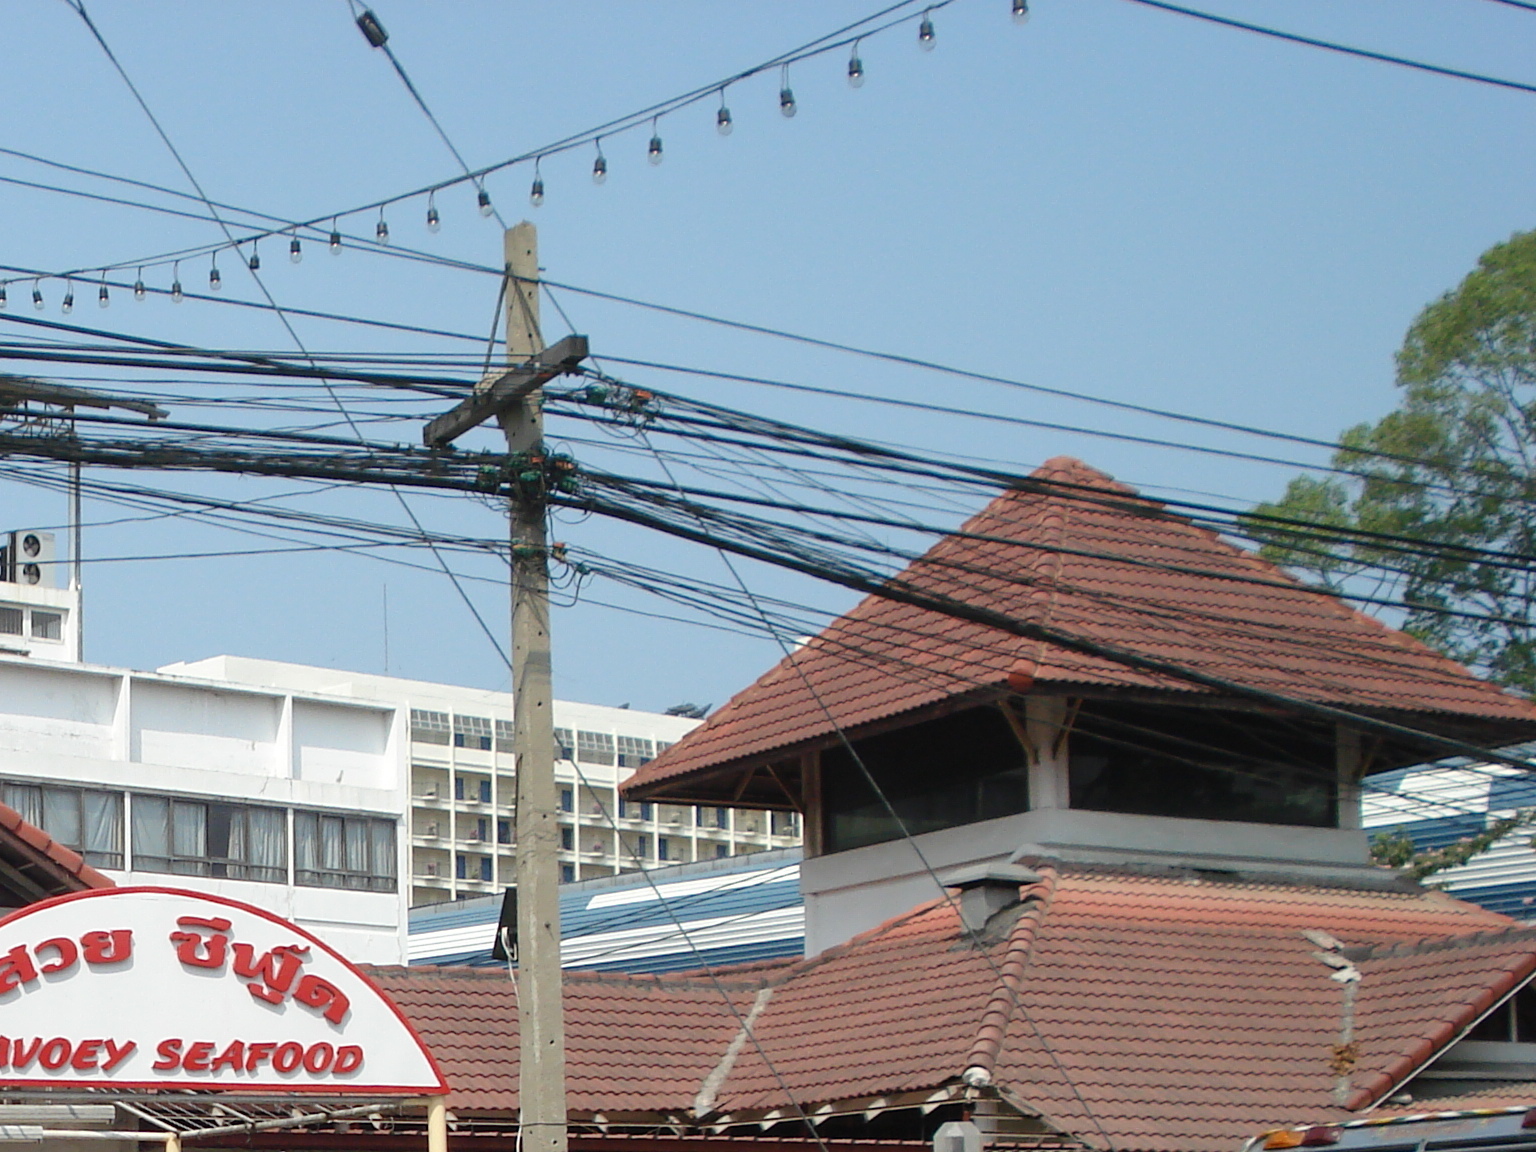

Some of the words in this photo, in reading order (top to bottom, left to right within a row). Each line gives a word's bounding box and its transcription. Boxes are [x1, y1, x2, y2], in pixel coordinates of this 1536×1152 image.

[170, 916, 352, 1024] ซีฟู้ด
[153, 1039, 364, 1074] SEAFOOD
